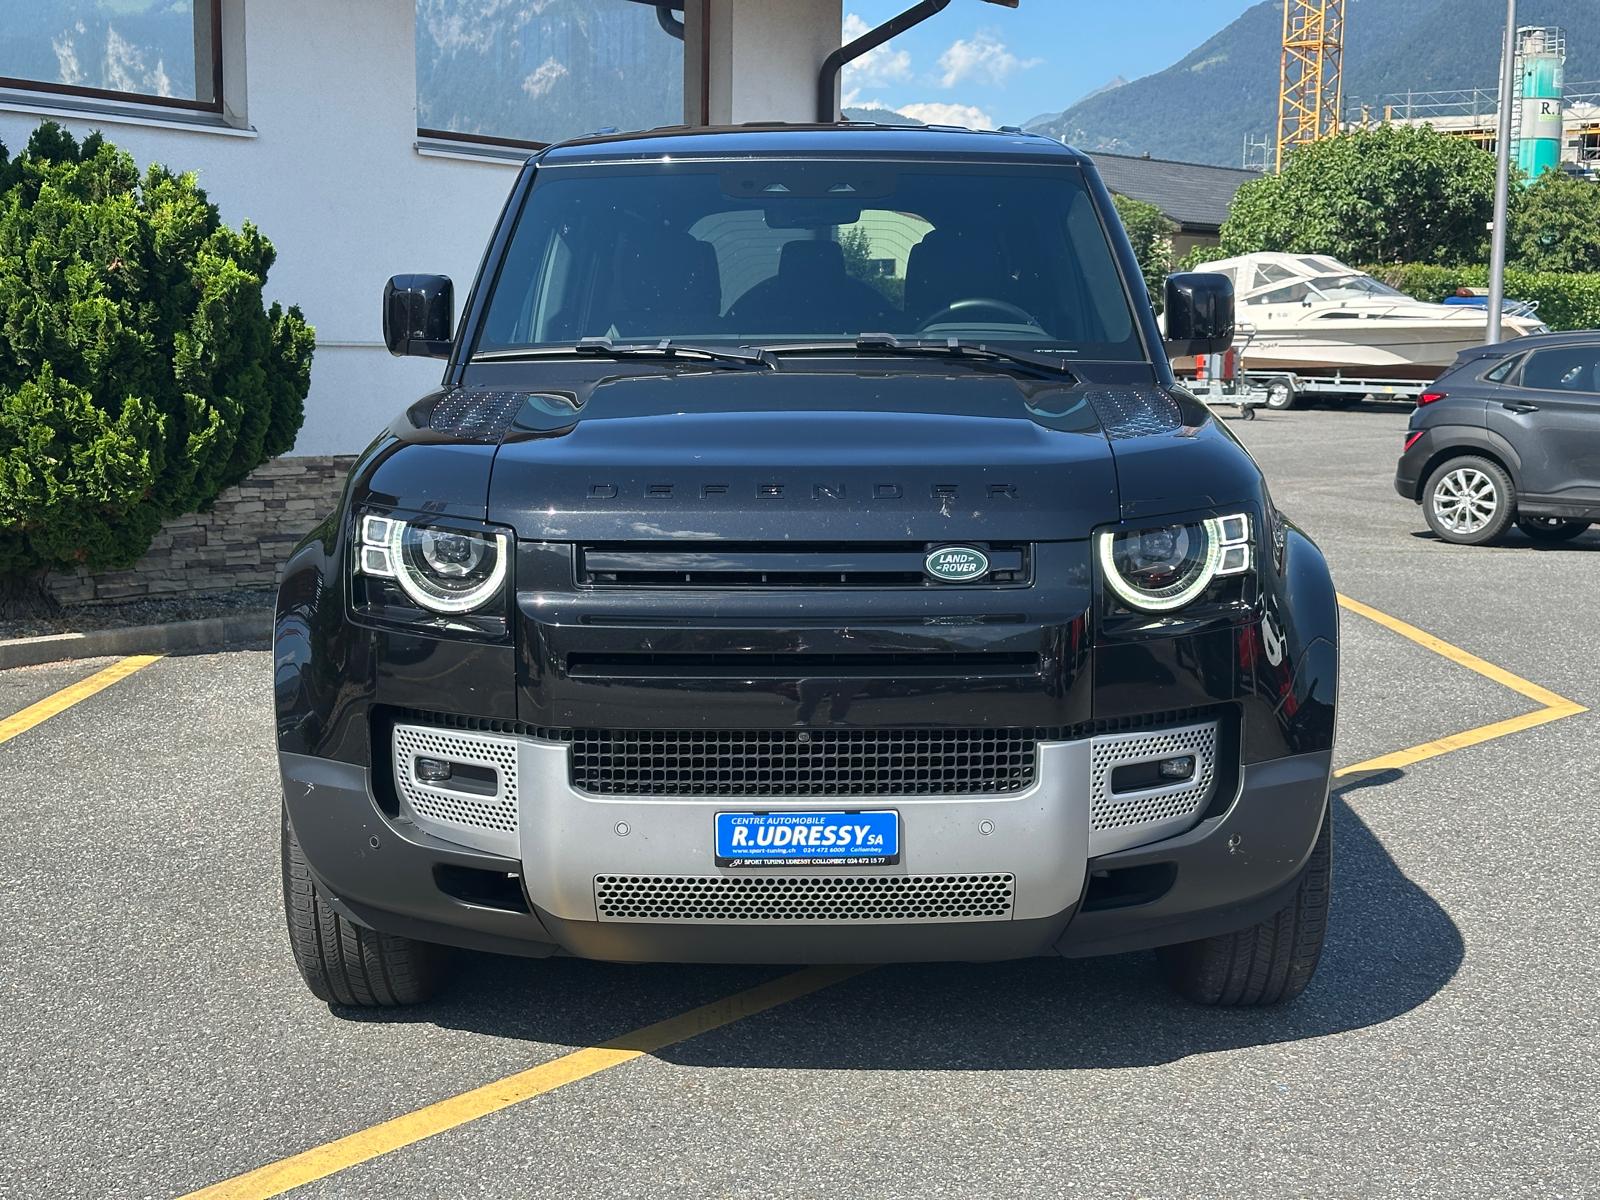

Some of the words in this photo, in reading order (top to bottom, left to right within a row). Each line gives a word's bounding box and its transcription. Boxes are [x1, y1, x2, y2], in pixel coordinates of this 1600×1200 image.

[586, 483, 1019, 500] DEFENDER
[939, 554, 968, 564] LAND
[942, 563, 977, 572] ROVER
[731, 817, 766, 825] CENTRE
[766, 817, 826, 825] AUTOMOBILE
[731, 825, 871, 847] R.UDRESSY
[867, 834, 884, 845] SA
